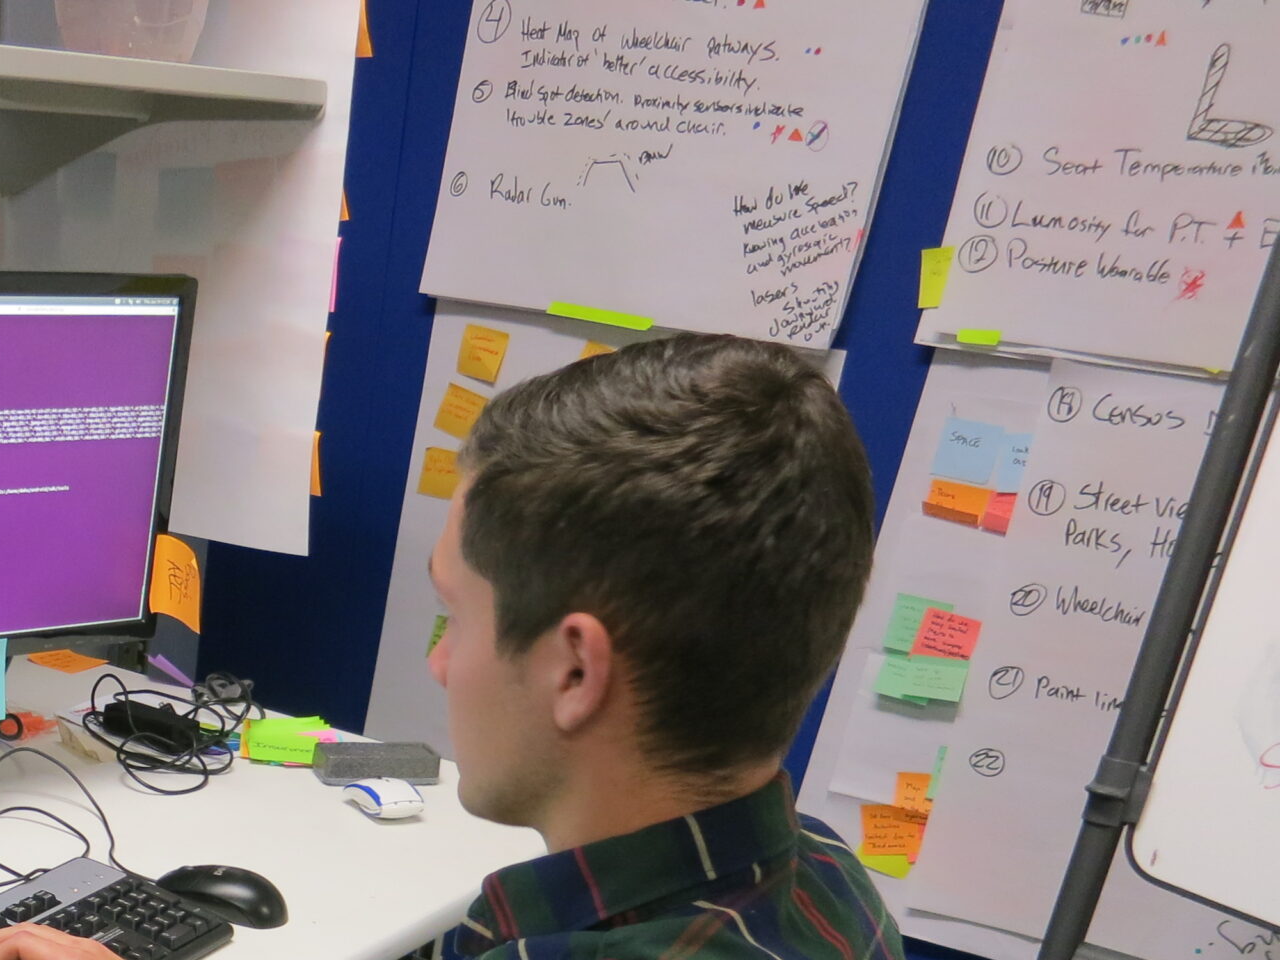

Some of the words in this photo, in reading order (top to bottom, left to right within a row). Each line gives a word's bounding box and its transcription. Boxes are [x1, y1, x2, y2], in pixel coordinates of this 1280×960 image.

[481, 1, 508, 42] 4
[521, 16, 551, 42] Heat
[556, 20, 580, 49] Map
[1043, 146, 1102, 175] Seat
[1073, 481, 1150, 516] Street
